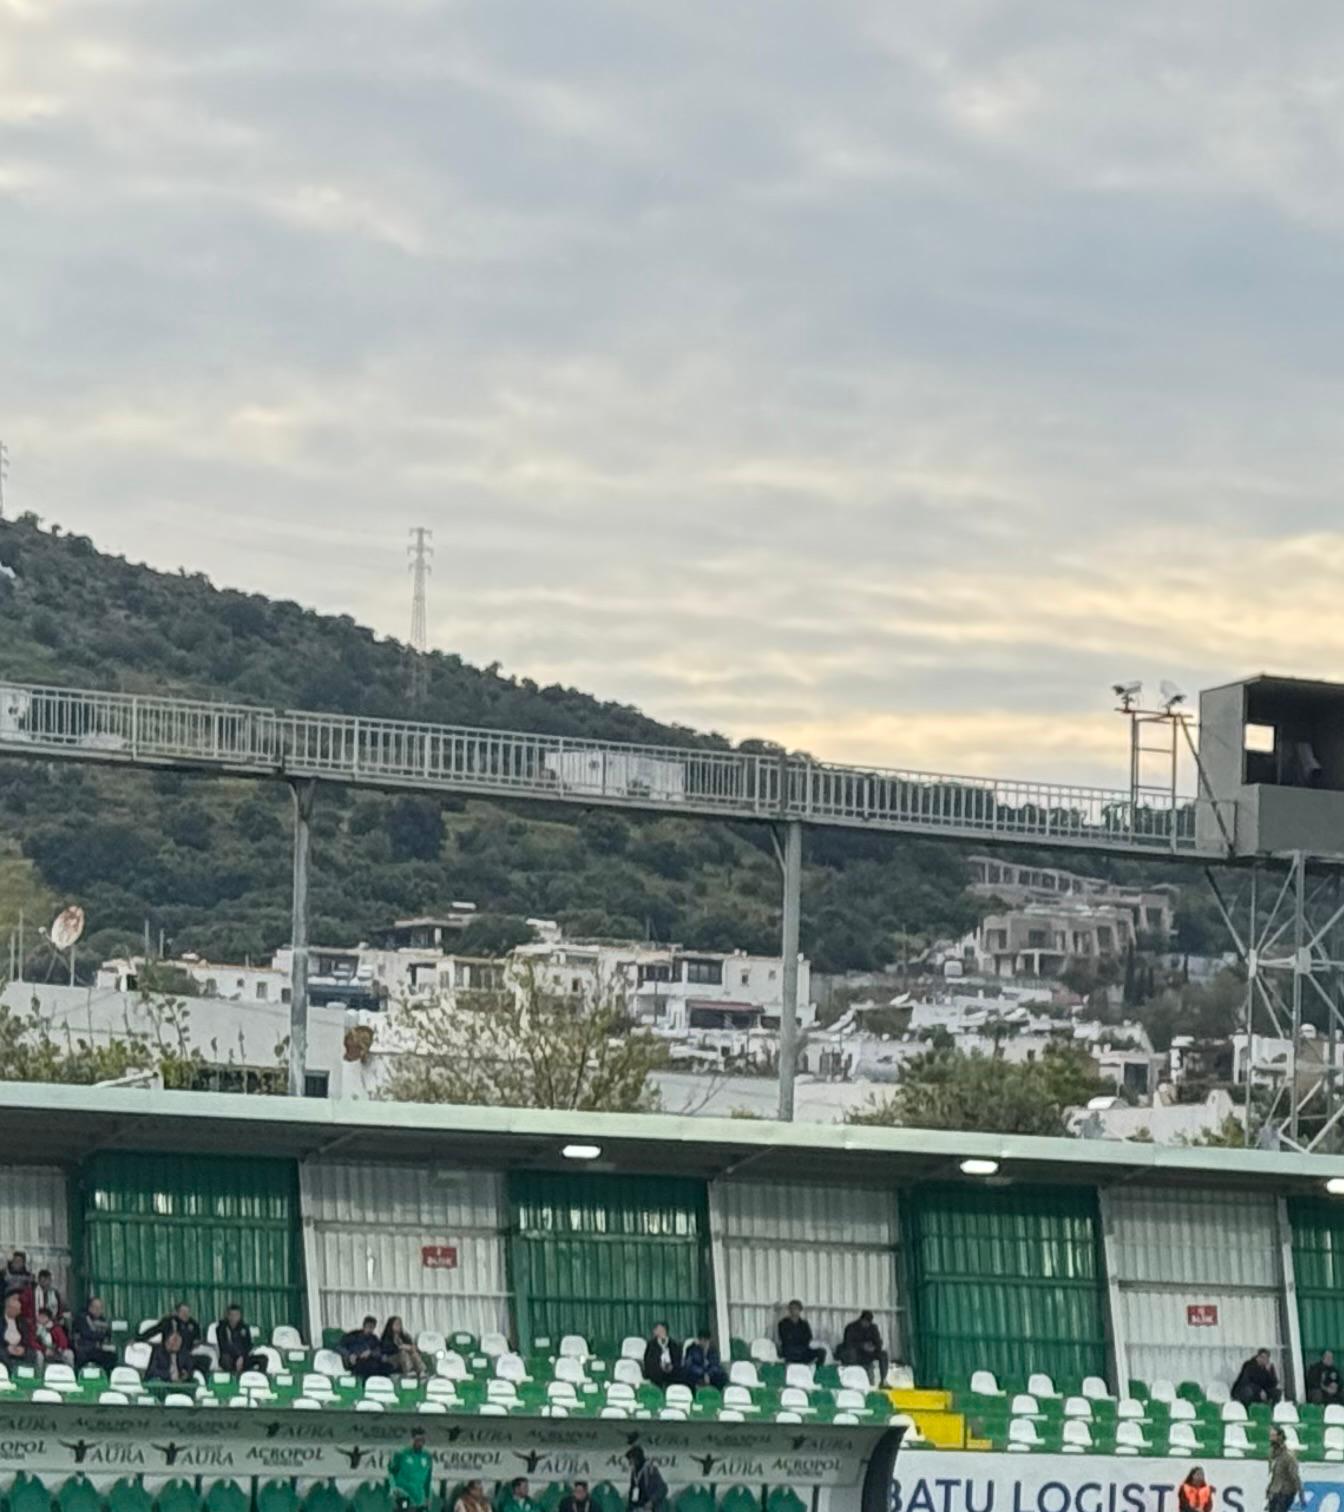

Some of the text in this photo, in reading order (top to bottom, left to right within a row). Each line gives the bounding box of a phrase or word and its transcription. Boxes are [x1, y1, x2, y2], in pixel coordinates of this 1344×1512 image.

[90, 1444, 145, 1465] AURA
[181, 1447, 235, 1468] AURA
[542, 1455, 591, 1475] AURA
[715, 1458, 764, 1477] AURA
